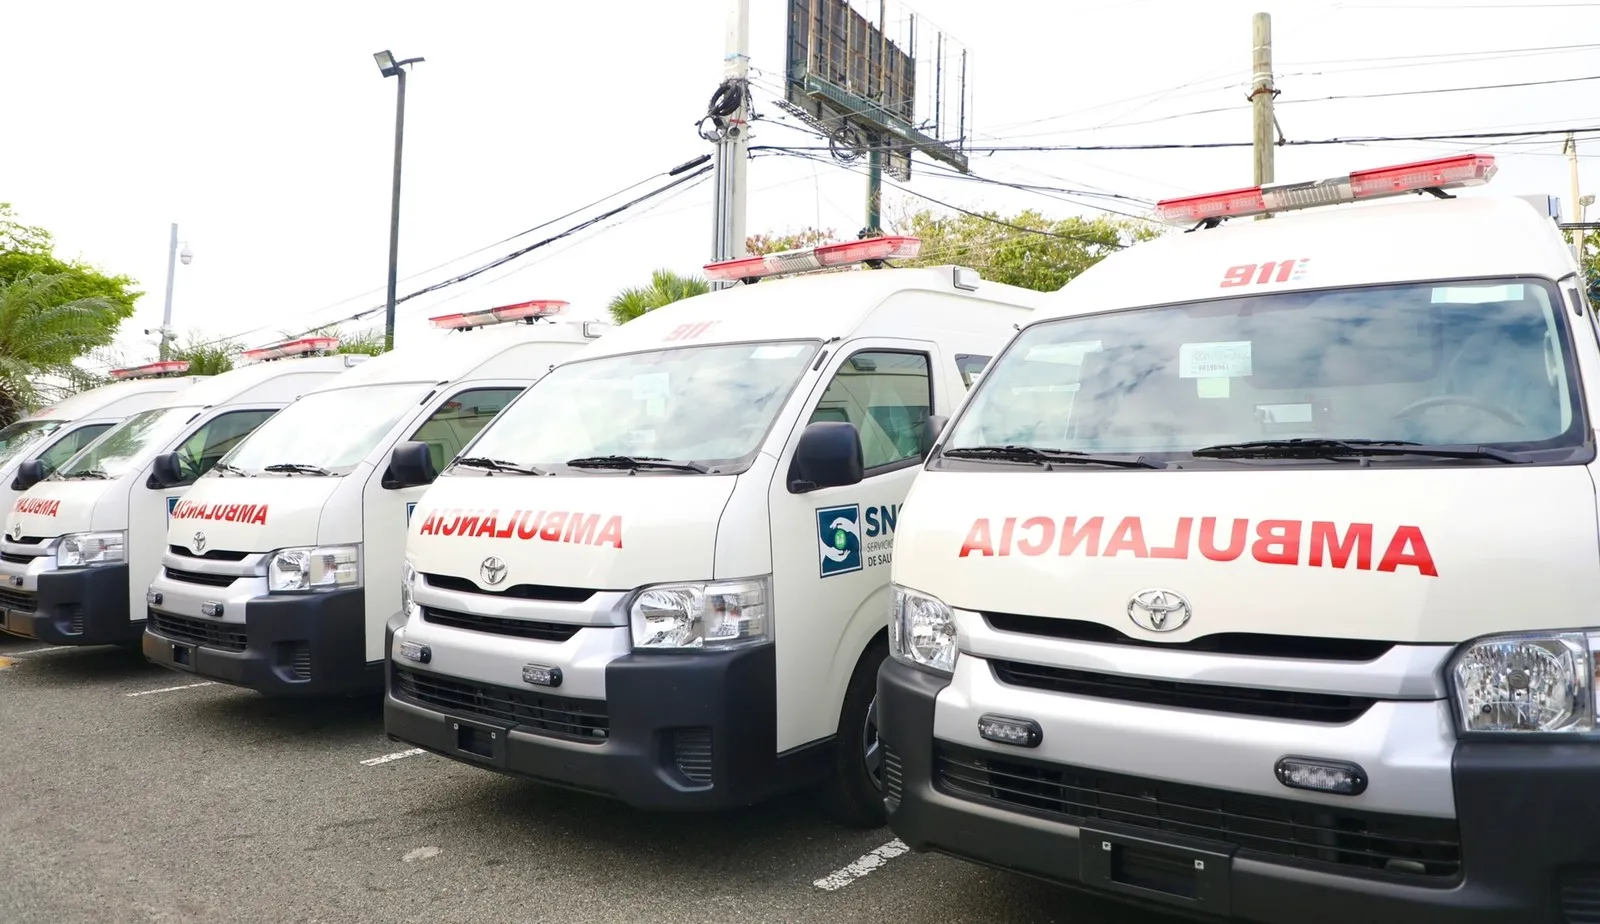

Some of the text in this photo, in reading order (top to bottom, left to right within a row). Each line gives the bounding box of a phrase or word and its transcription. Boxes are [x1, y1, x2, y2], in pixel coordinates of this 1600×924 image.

[1220, 259, 1296, 288] 911
[662, 321, 714, 342] 911
[865, 502, 904, 537] SN
[868, 555, 877, 567] DE
